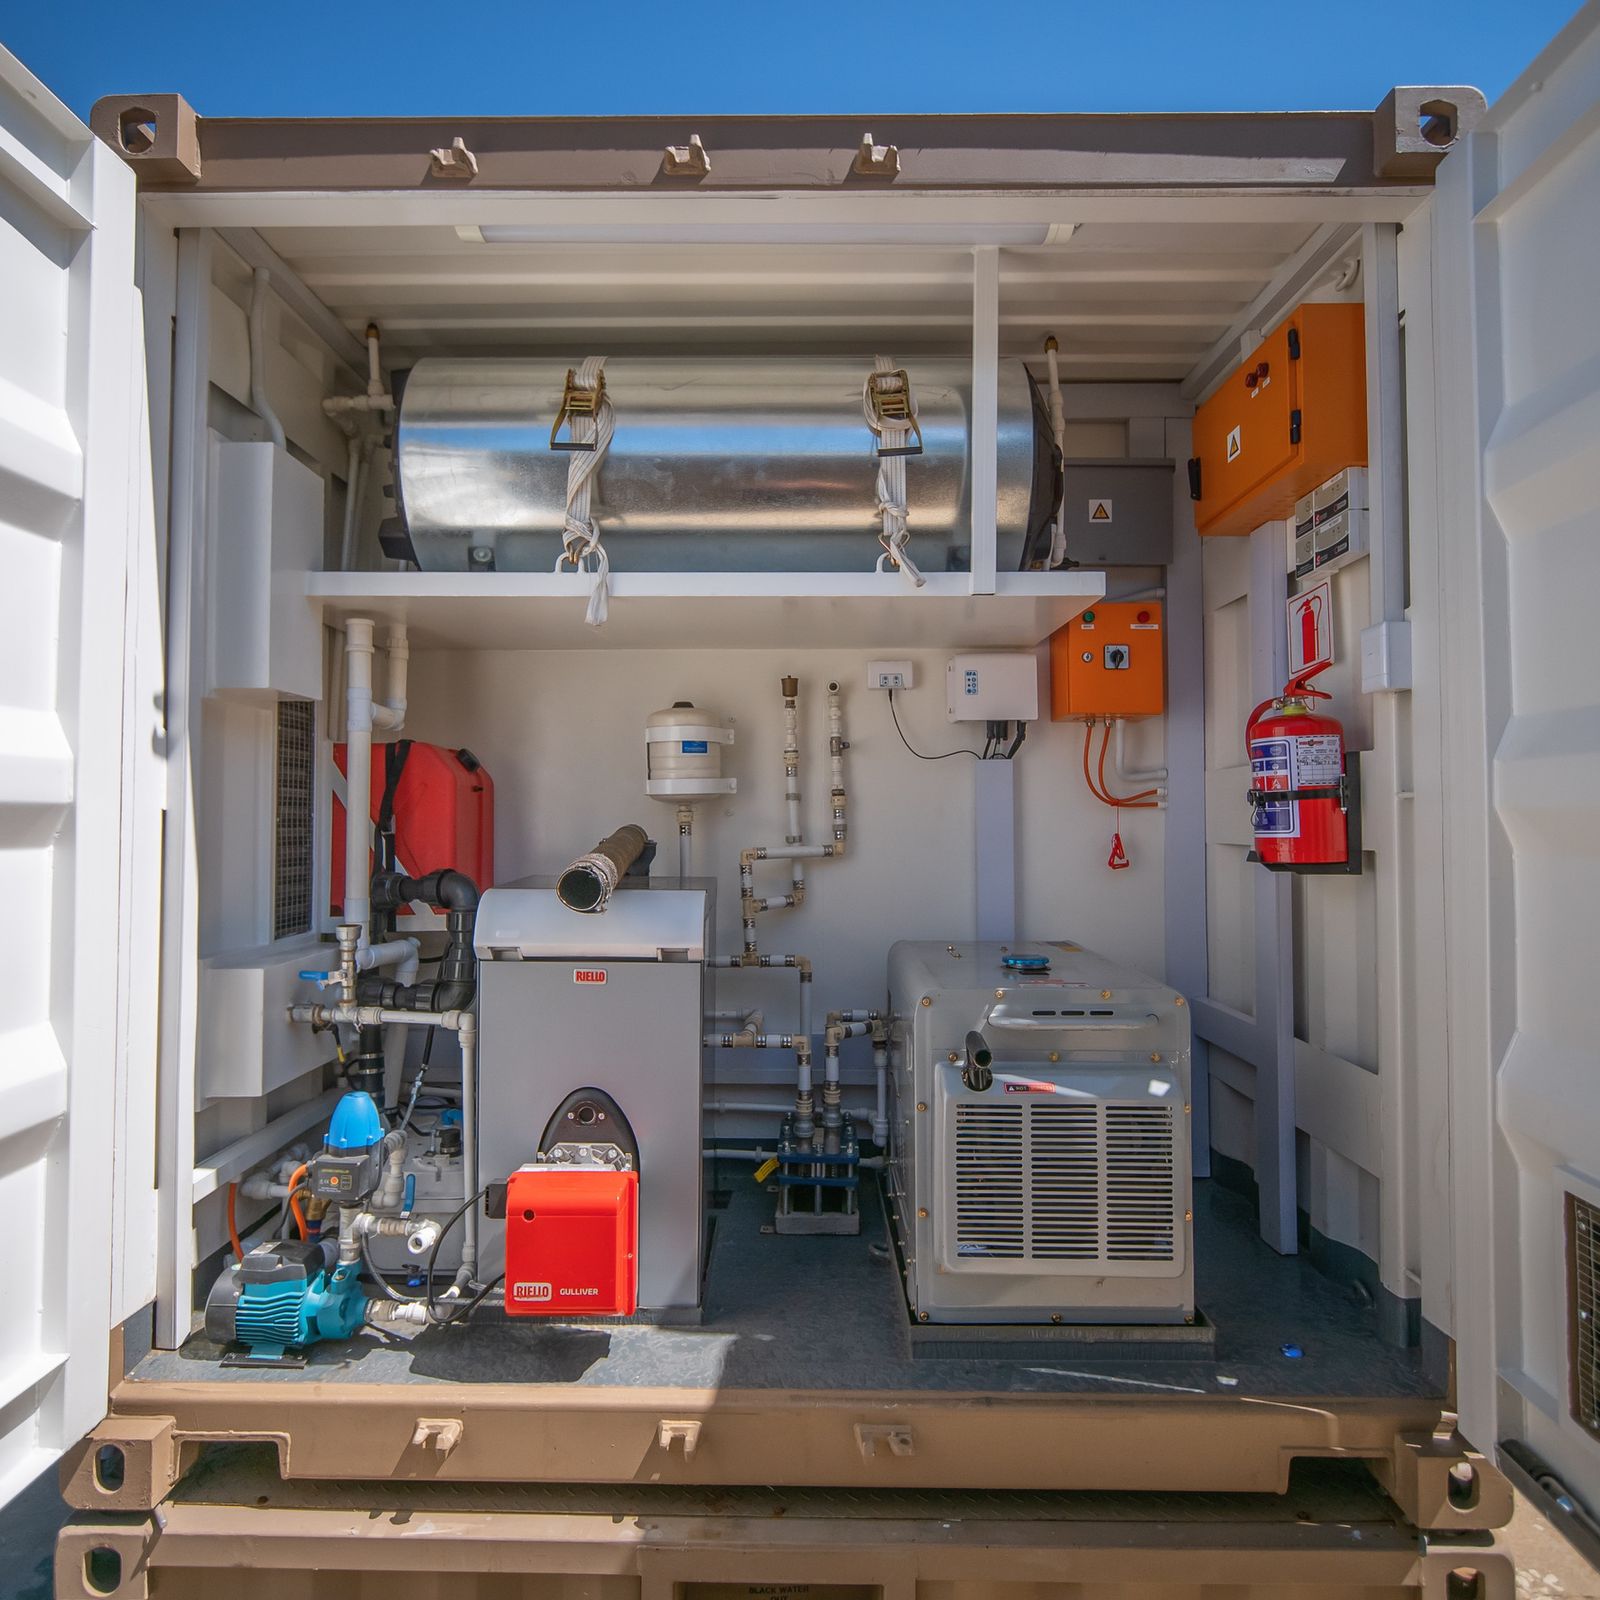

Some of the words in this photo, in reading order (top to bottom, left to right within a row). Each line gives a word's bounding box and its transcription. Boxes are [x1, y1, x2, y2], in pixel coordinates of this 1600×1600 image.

[575, 970, 606, 982] RIELLO
[516, 1285, 549, 1297] RIELLO
[559, 1288, 599, 1296] GULLIVER
[779, 1585, 809, 1593] WATER
